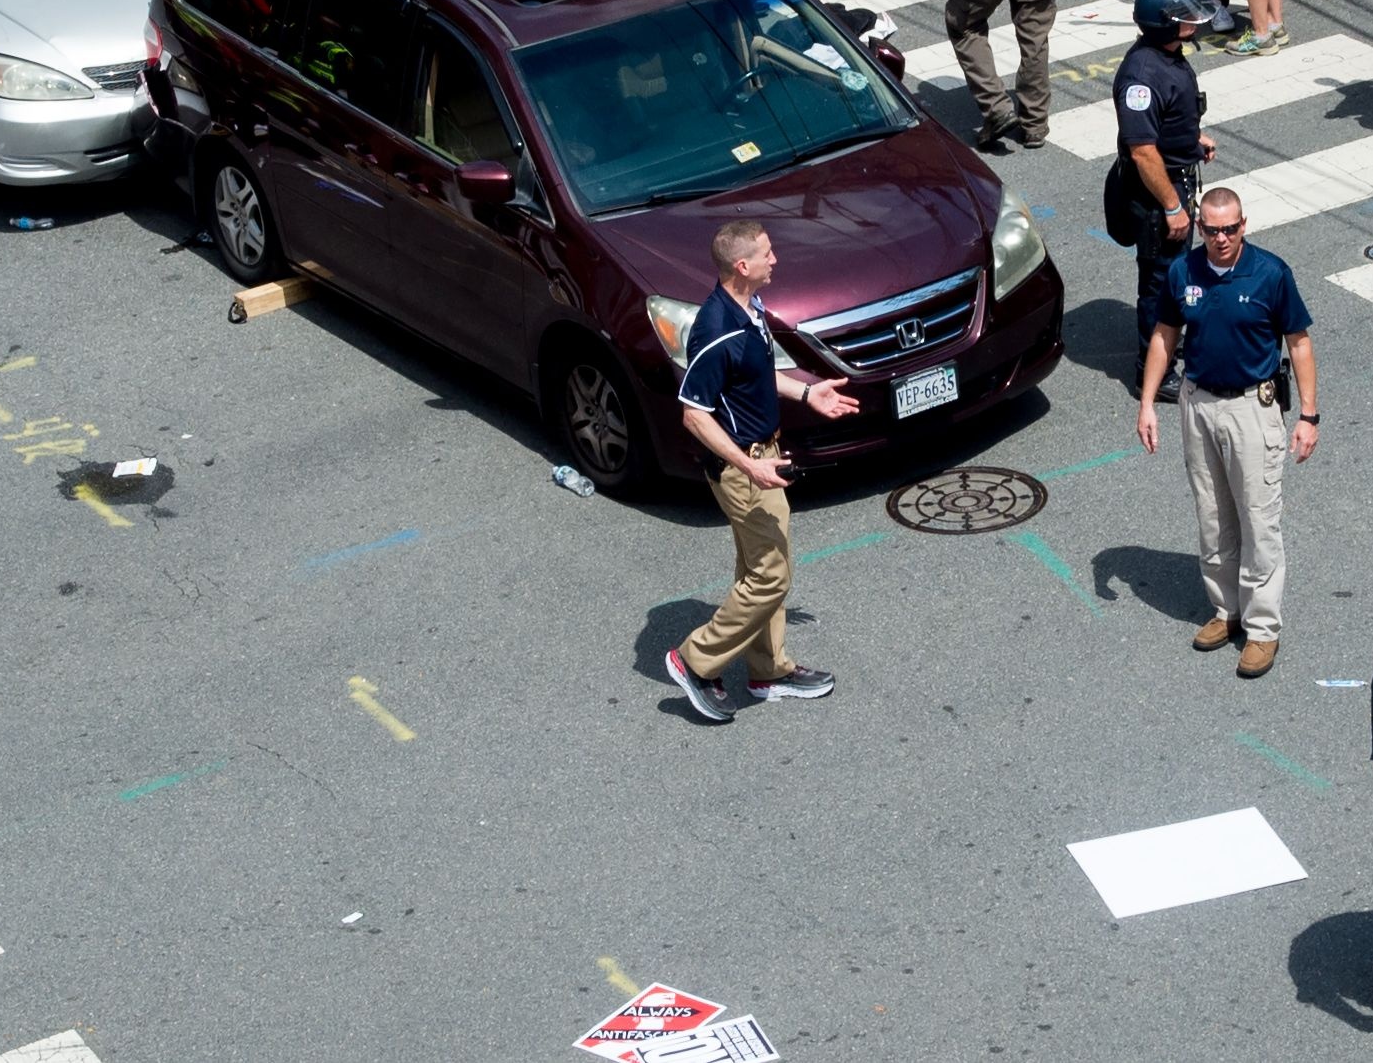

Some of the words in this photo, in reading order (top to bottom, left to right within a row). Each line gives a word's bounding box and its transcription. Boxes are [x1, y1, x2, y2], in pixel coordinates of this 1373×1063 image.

[897, 374, 956, 408] VEP-6635
[623, 1006, 693, 1018] ALWAYS
[590, 1030, 679, 1043] ANTIFASCI
